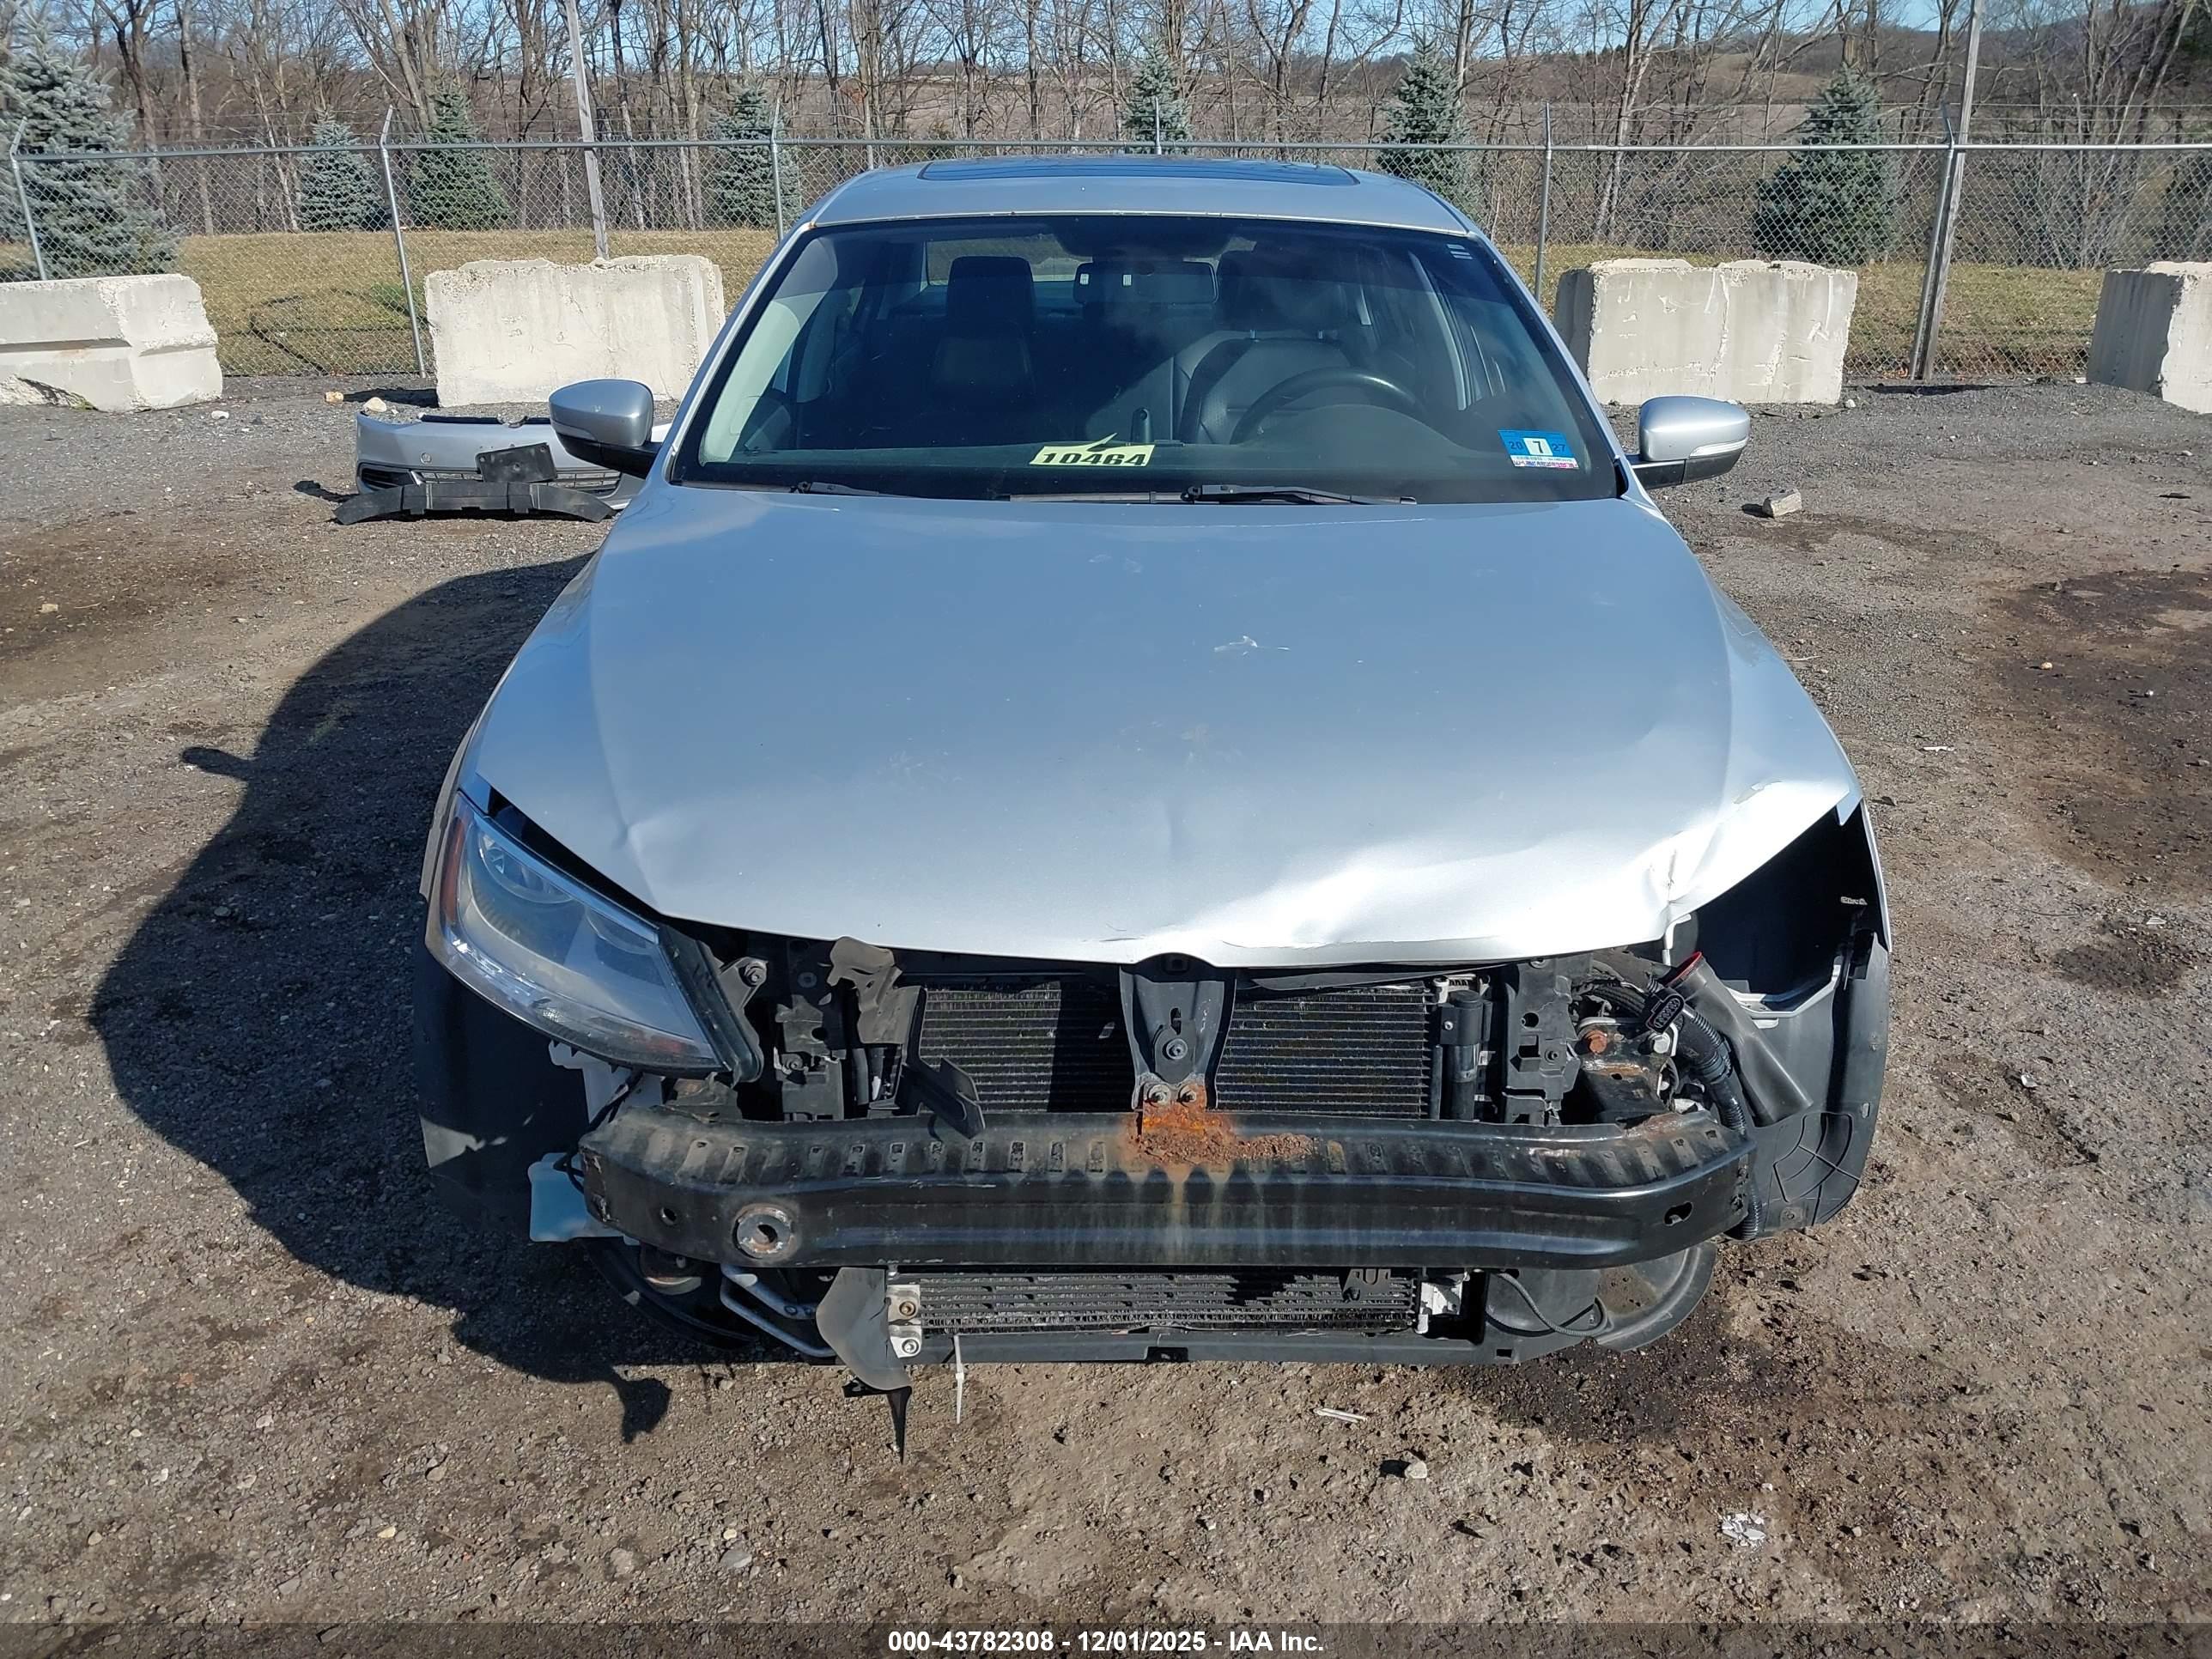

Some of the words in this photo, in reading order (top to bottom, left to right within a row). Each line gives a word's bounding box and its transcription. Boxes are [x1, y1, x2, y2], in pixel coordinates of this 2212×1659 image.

[1509, 441, 1523, 450] 20
[1532, 441, 1544, 454] 7
[1553, 443, 1566, 453] 27
[1042, 453, 1146, 465] 10464
